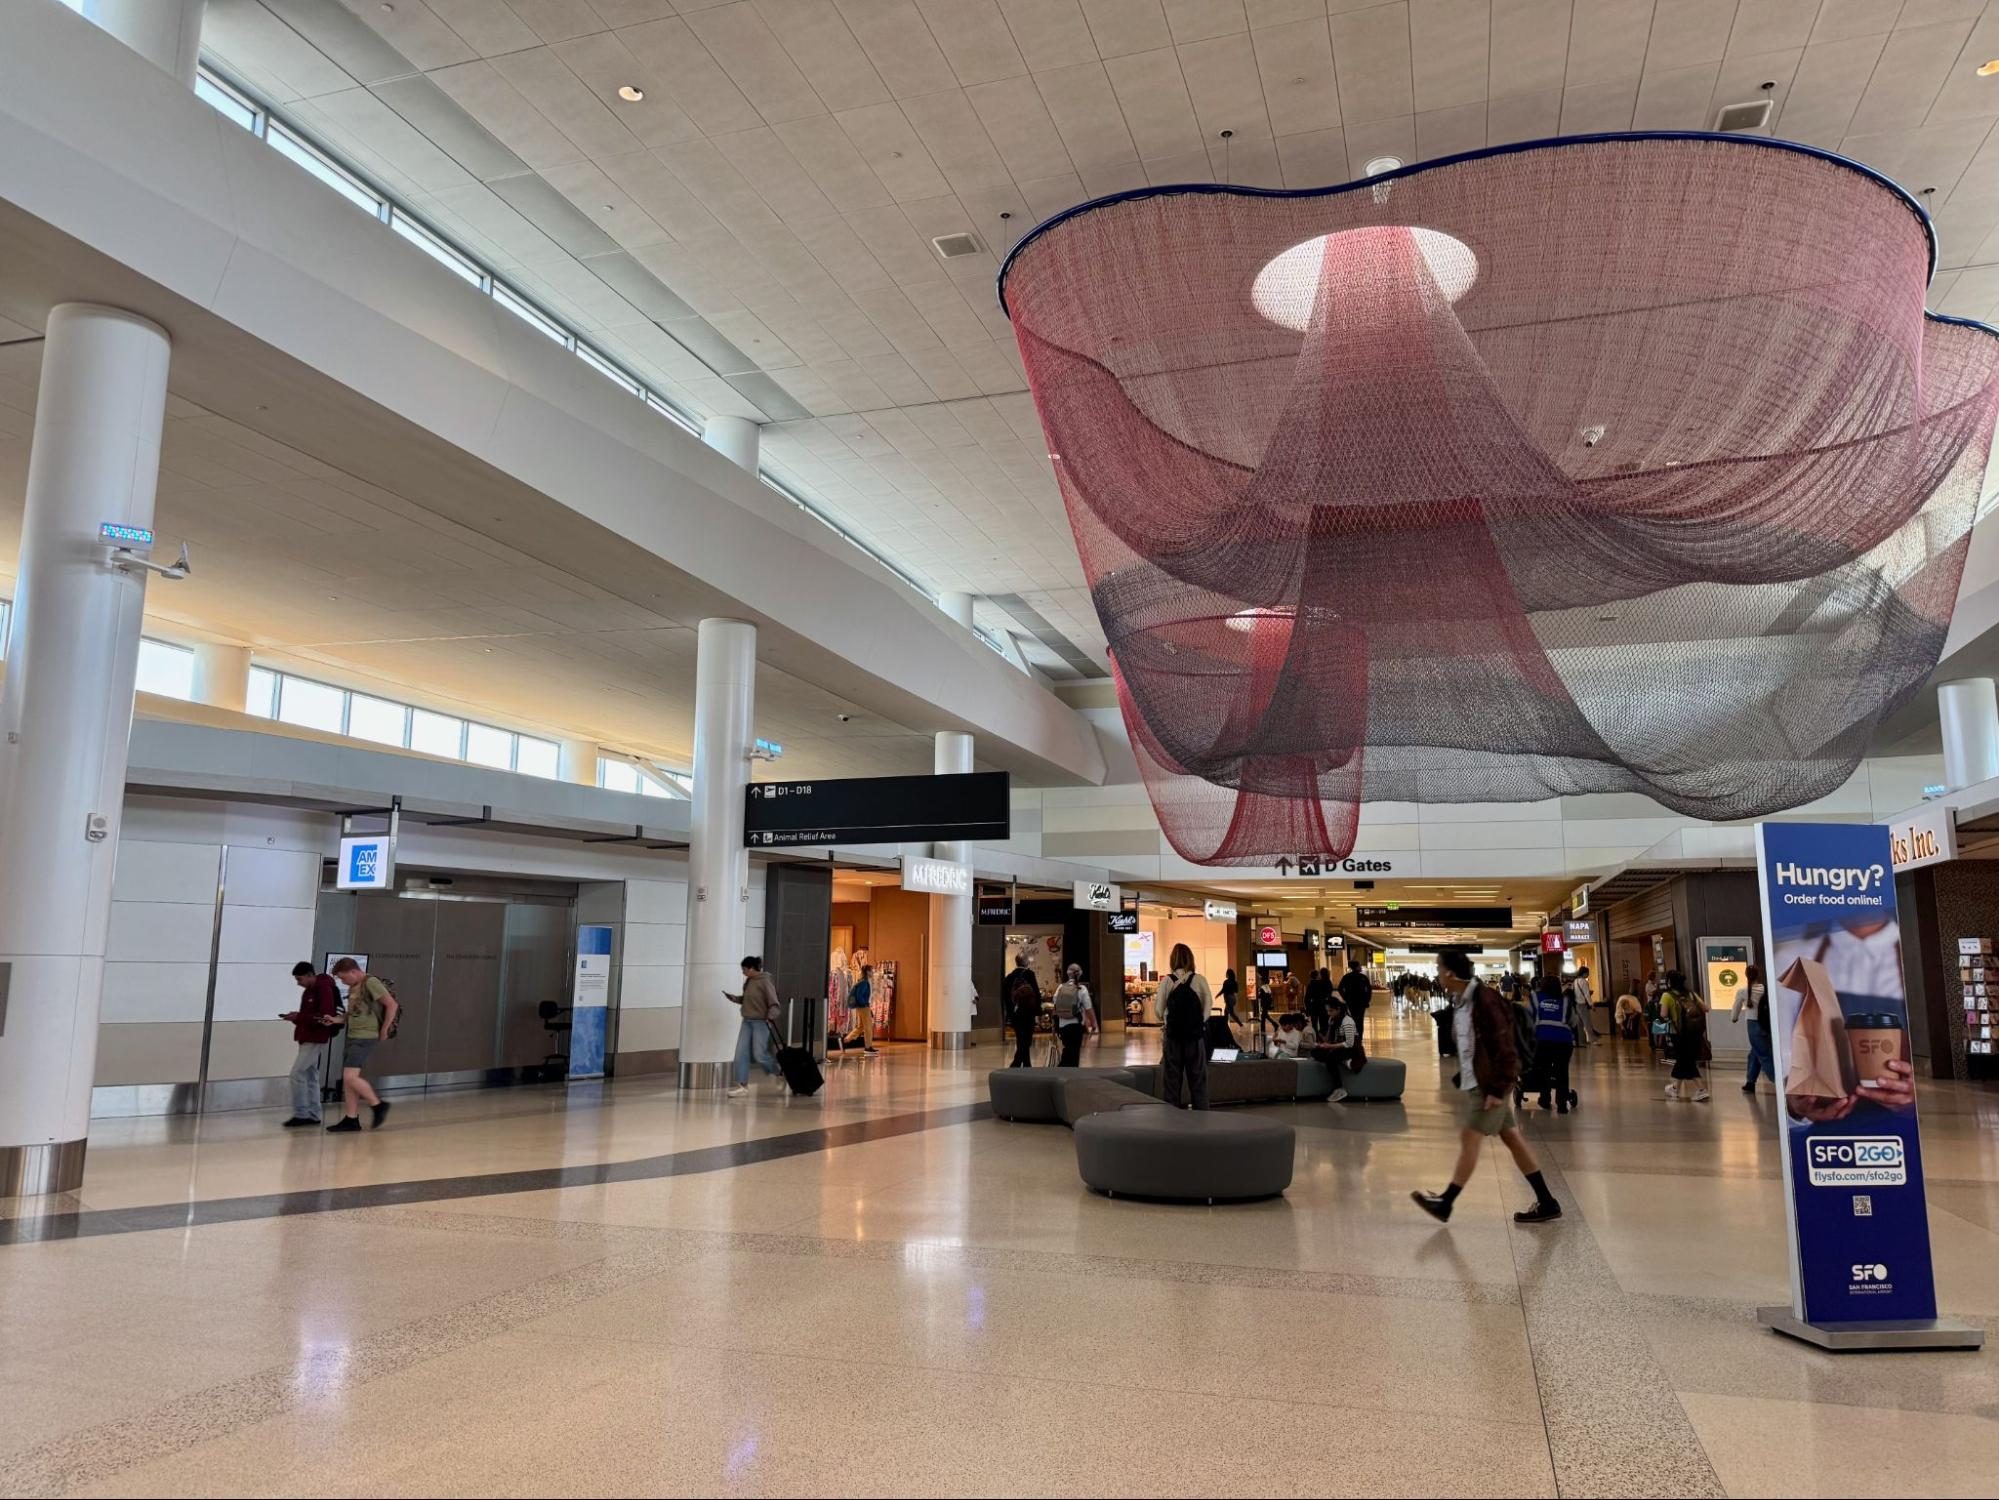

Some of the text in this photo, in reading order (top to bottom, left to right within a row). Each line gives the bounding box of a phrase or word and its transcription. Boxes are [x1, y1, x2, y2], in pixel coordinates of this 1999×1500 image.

[778, 786, 788, 796] D1
[796, 785, 812, 795] D18
[774, 831, 836, 841] Animal Relief Area
[1909, 826, 1940, 860] Inc.
[358, 851, 377, 863] AM
[1325, 858, 1392, 872] D Gates
[1776, 863, 1884, 891] Hungry?
[1784, 893, 1883, 905] Order food online!
[1569, 922, 1589, 930] NAPA
[1262, 932, 1275, 940] DFS
[1859, 1039, 1893, 1054] SFO
[1815, 1146, 1895, 1162] SFO 2GO
[1814, 1171, 1903, 1182] flysfo.com/sfo2go
[1852, 1264, 1887, 1280] SFO
